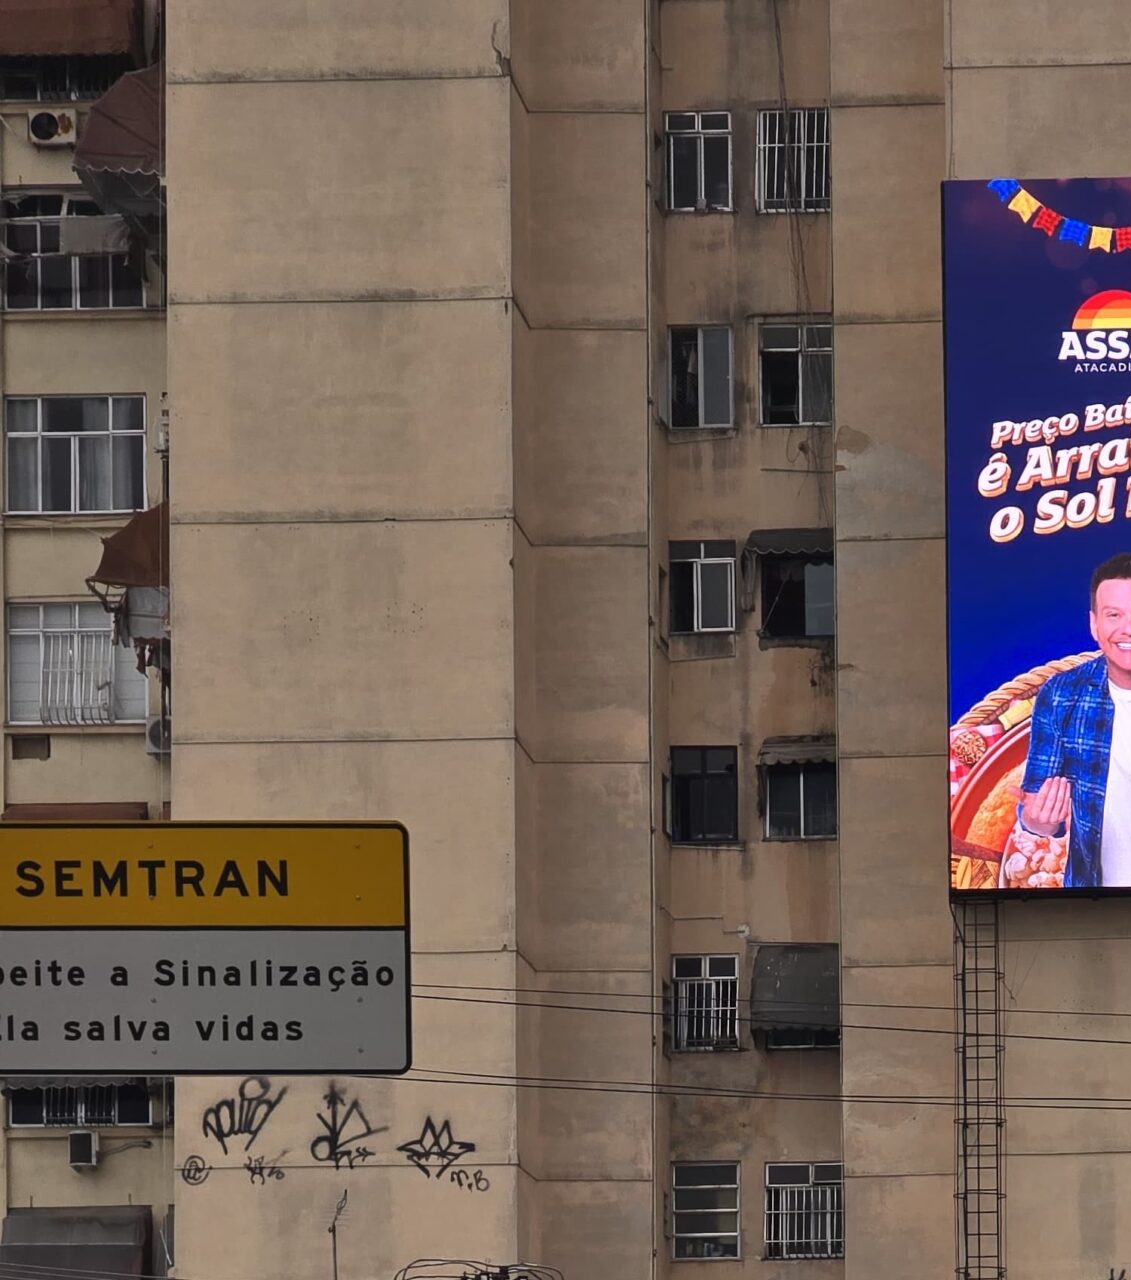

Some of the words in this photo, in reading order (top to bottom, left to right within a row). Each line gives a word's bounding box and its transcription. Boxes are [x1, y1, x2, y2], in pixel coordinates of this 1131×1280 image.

[991, 412, 1078, 449] Preço
[977, 452, 1011, 497] é
[989, 505, 1024, 543] o
[1033, 476, 1115, 535] Sol
[15, 859, 289, 897] SEMTRAN
[110, 964, 129, 987] a
[154, 958, 395, 992] Sinalização
[0, 1014, 39, 1042] la
[63, 1014, 170, 1042] salva
[195, 1014, 304, 1042] vidas
